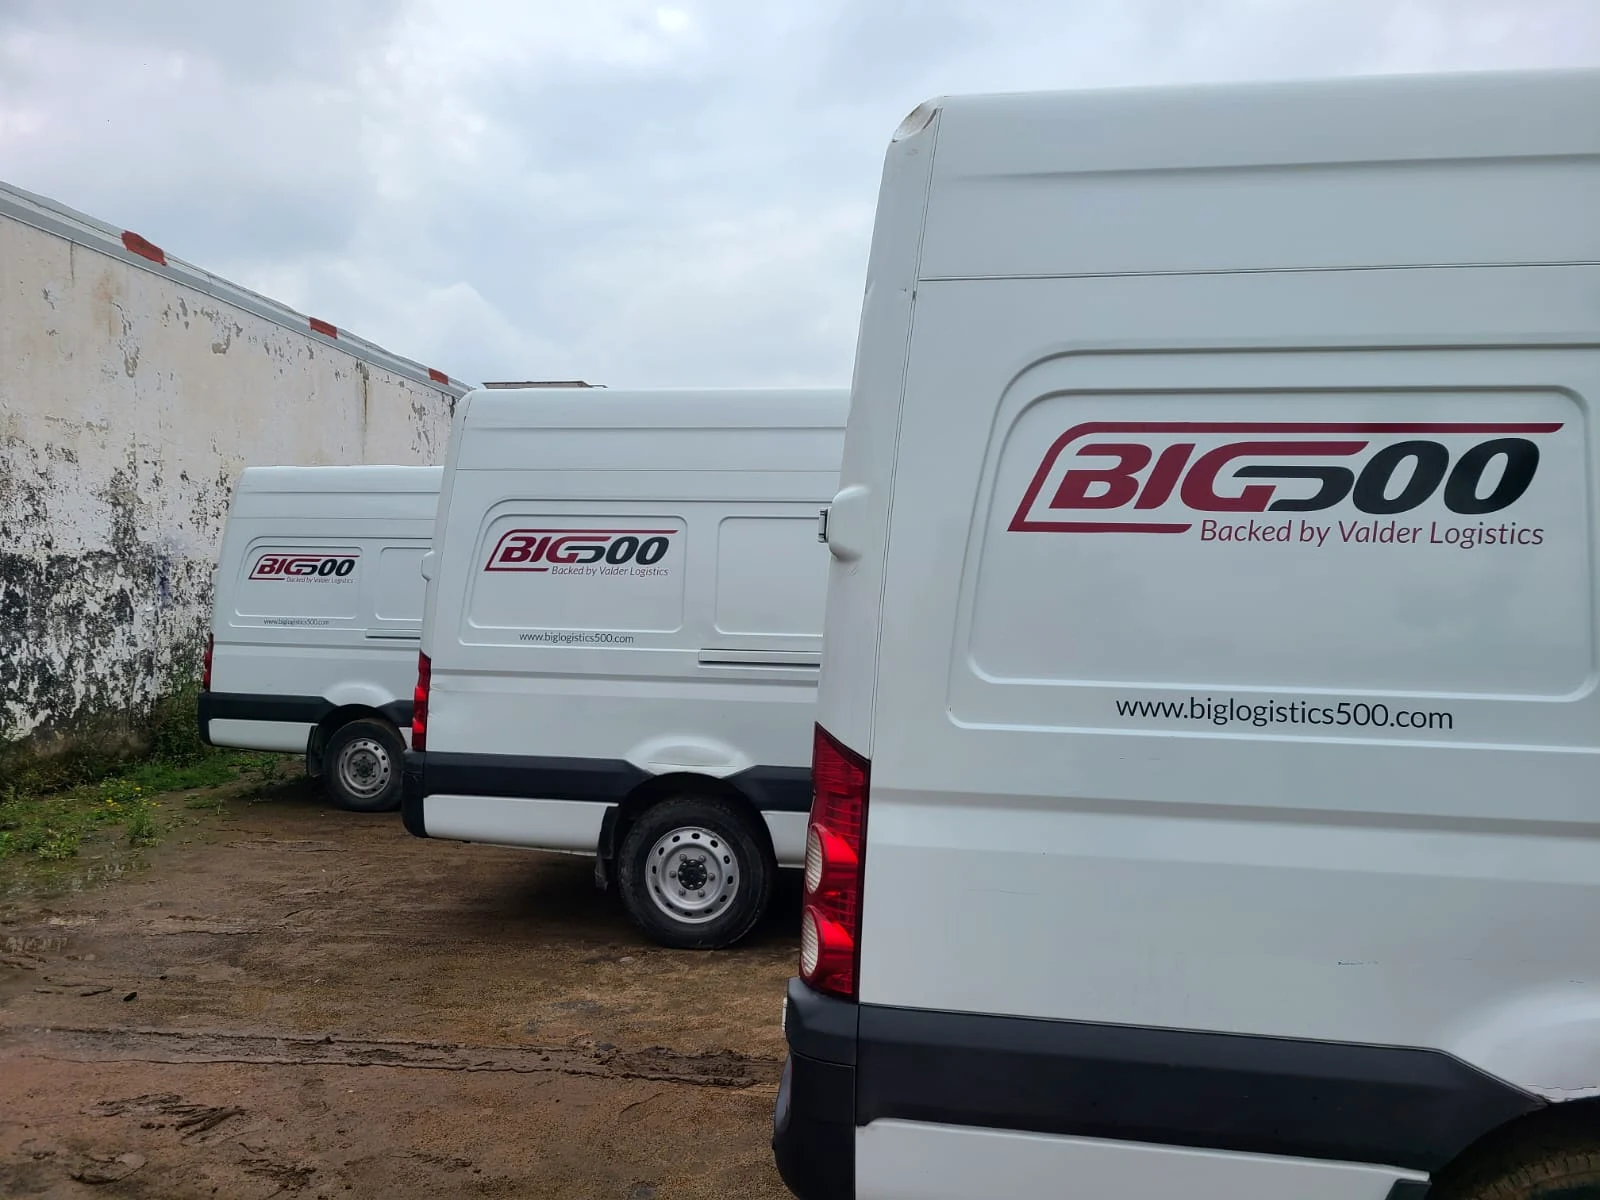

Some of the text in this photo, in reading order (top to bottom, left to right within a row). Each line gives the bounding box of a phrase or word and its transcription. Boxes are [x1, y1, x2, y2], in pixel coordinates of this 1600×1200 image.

[1200, 519, 1544, 549] Backed by Valder Logistics
[551, 566, 669, 578] Backed by Valder Logistics
[519, 632, 634, 644] www.biglogistics500.com
[1115, 696, 1453, 729] www.biglogistics500.com
